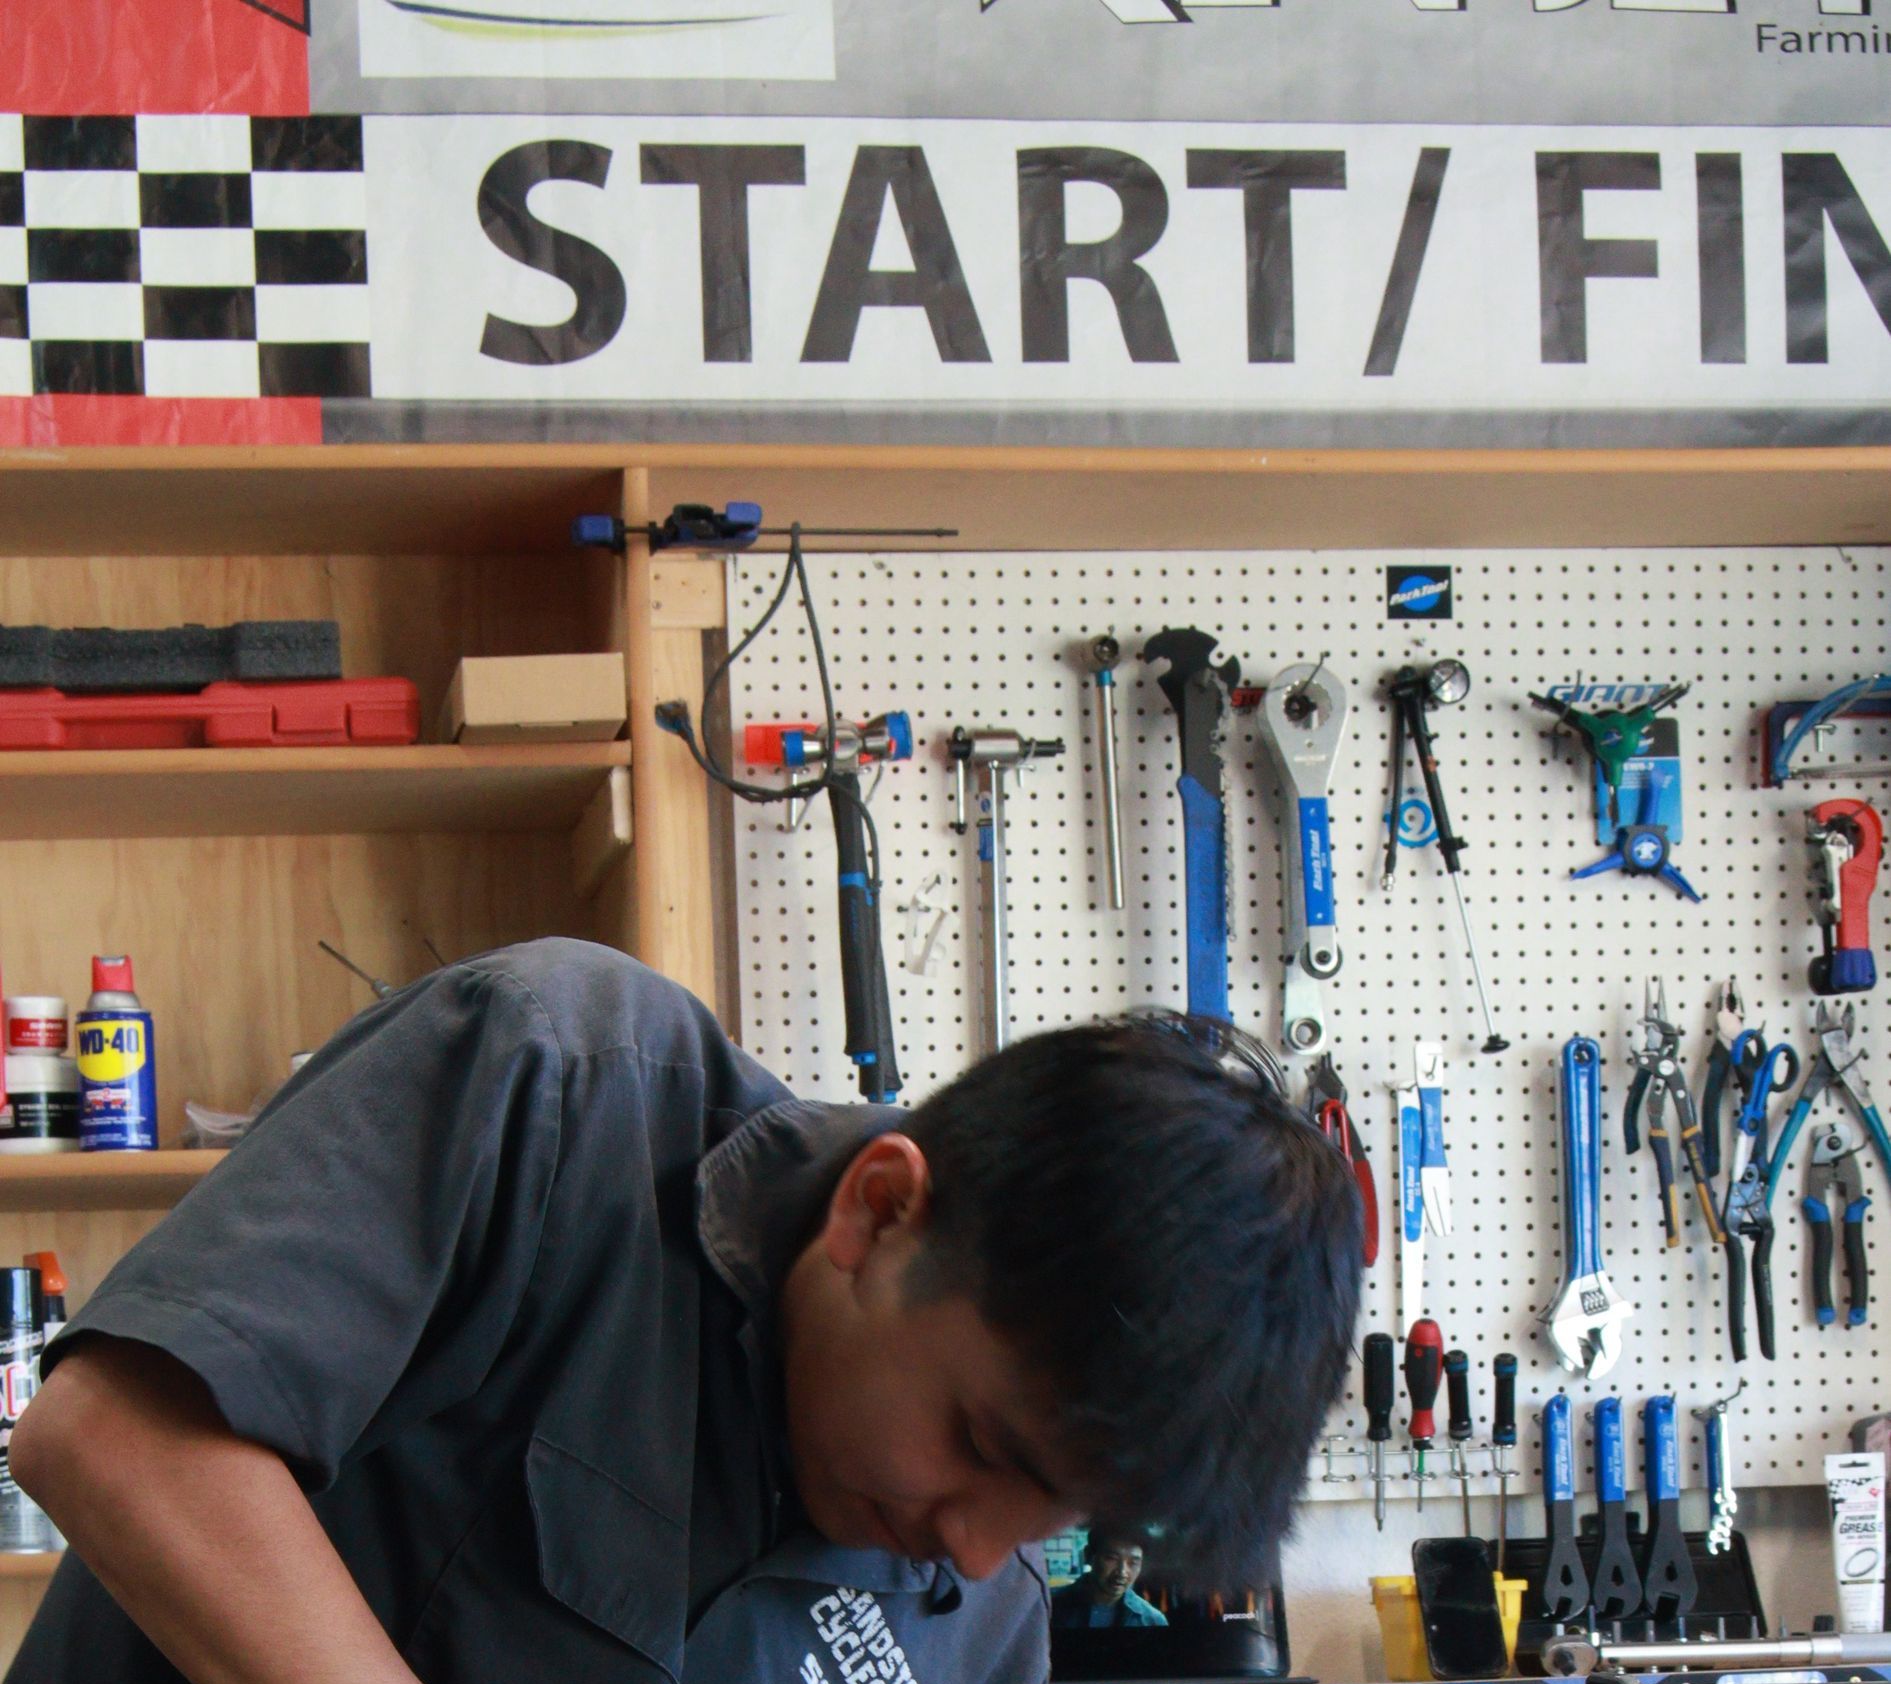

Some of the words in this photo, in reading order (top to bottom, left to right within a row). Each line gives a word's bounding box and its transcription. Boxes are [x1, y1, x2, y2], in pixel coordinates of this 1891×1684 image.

[1535, 150, 1891, 364] FIN
[1547, 683, 1669, 703] GIANT
[79, 1028, 139, 1056] WD-40
[1839, 1522, 1884, 1535] GREASE
